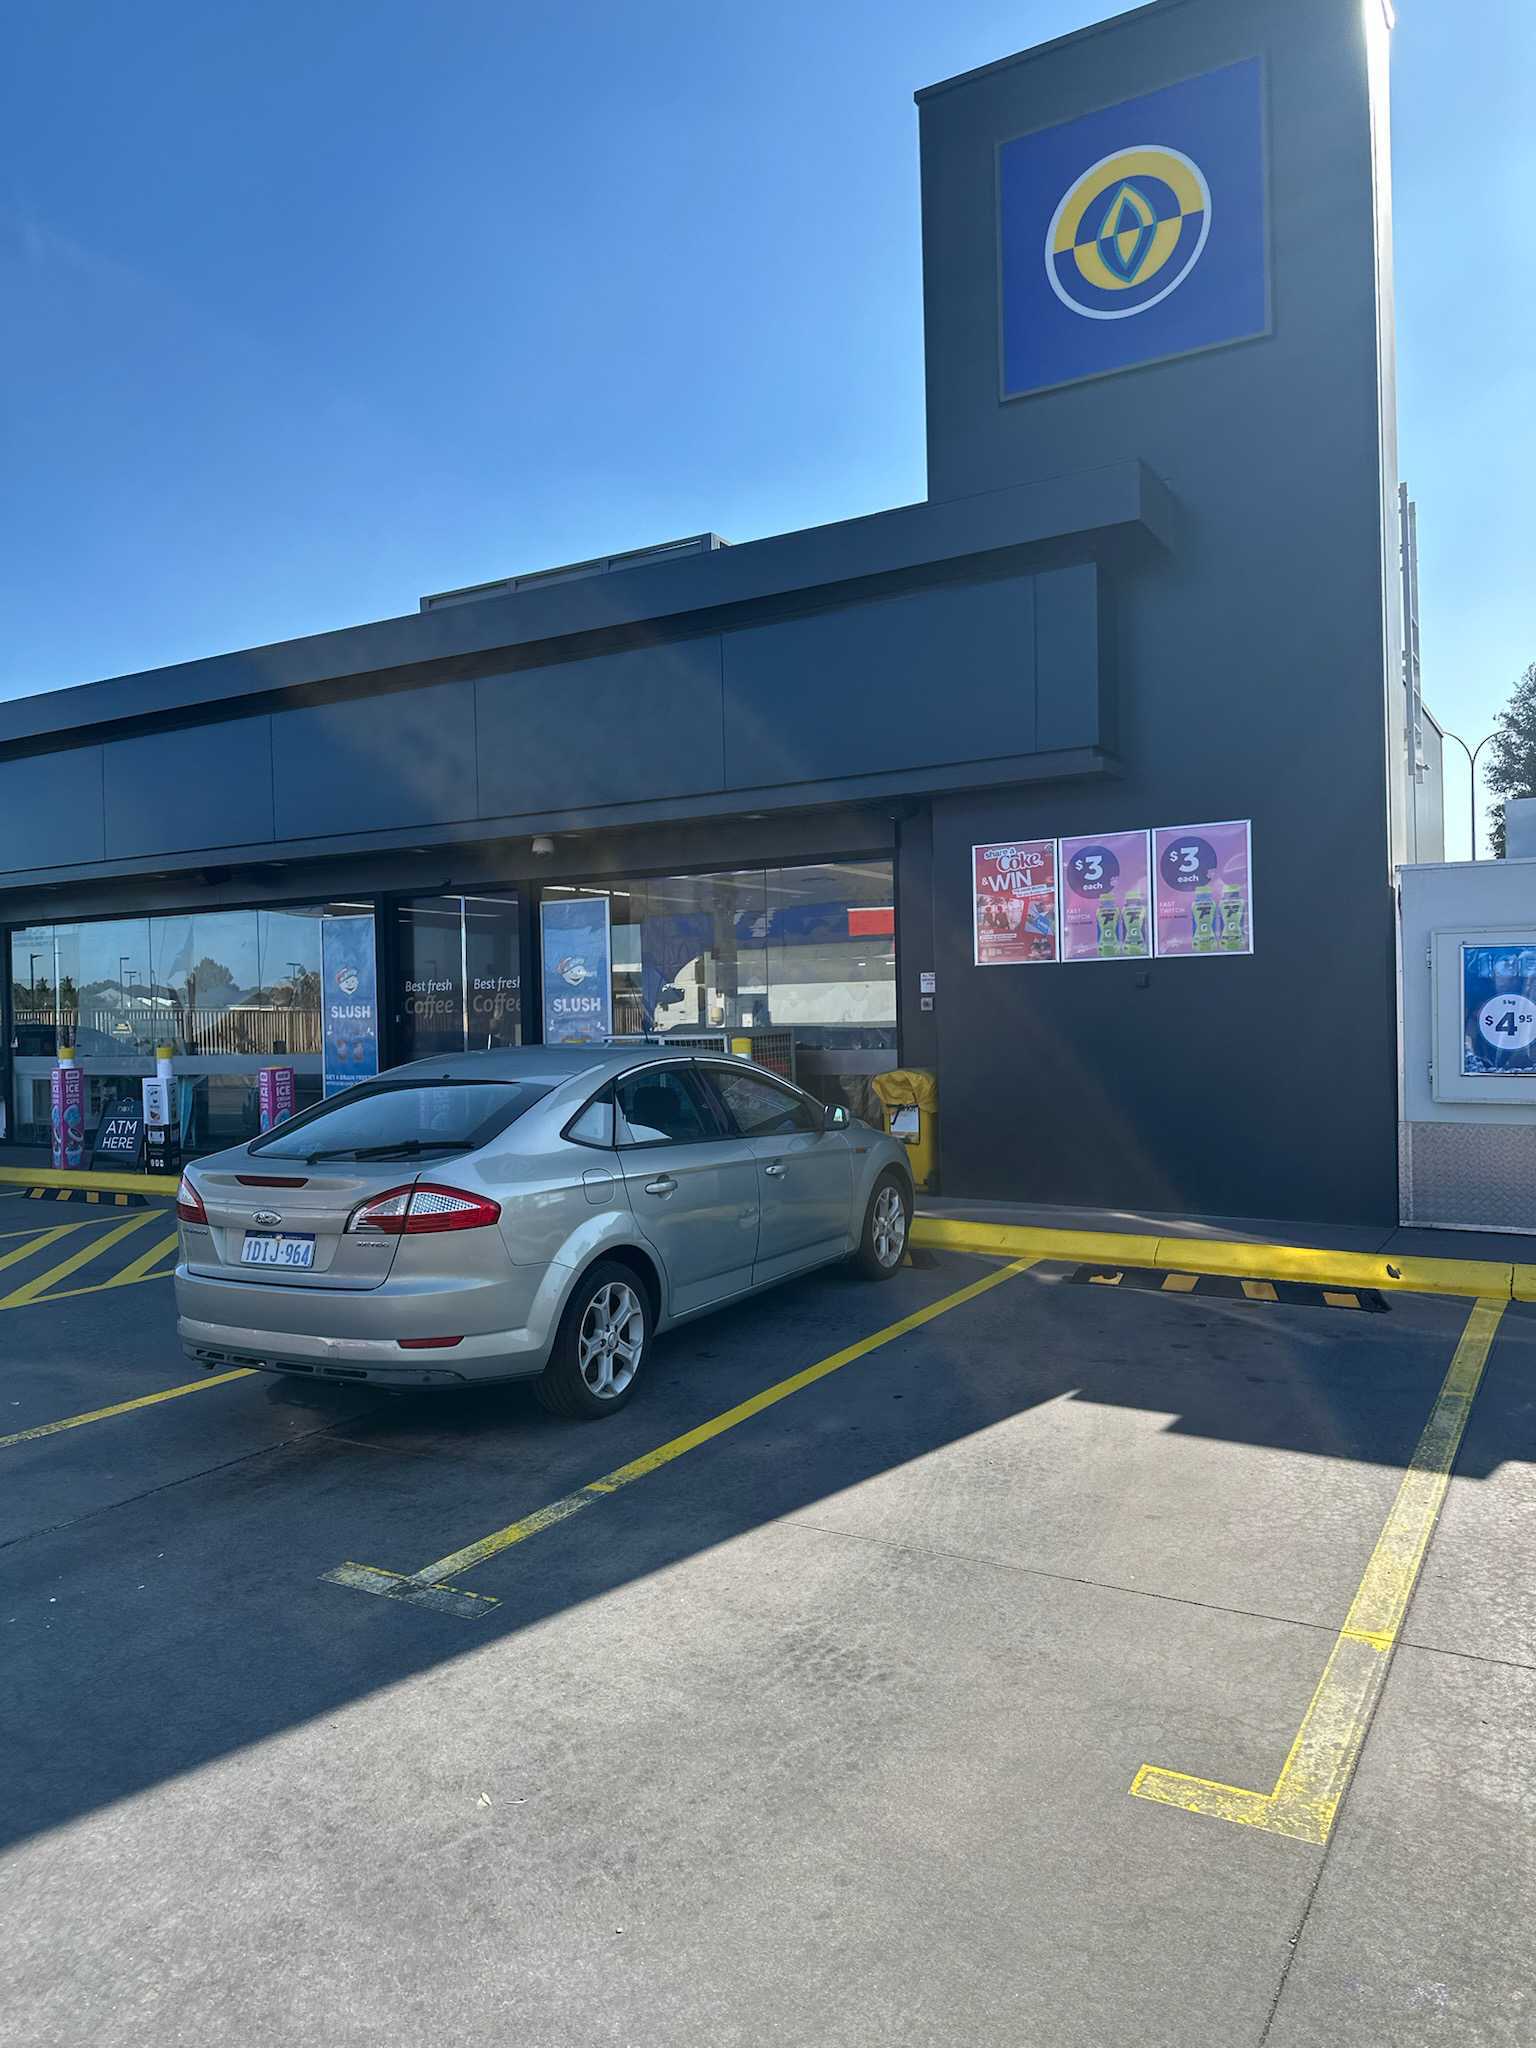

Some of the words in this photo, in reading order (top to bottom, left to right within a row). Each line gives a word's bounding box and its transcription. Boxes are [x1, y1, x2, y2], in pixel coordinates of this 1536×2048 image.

[985, 848, 1007, 859] share
[1169, 846, 1200, 873] $3
[1075, 855, 1103, 881] $3
[988, 869, 1032, 892] WIN
[1176, 874, 1199, 883] each
[1082, 882, 1103, 890] each
[405, 981, 425, 992] Best
[427, 979, 453, 994] fresh
[473, 978, 495, 990] Best
[331, 1005, 371, 1018] SLUSH
[405, 994, 454, 1019] Coffee
[552, 998, 601, 1012] SLUSH
[65, 1084, 80, 1093] ICE
[276, 1086, 290, 1097] ICE
[105, 1120, 138, 1134] ATM
[102, 1137, 135, 1149] HERE
